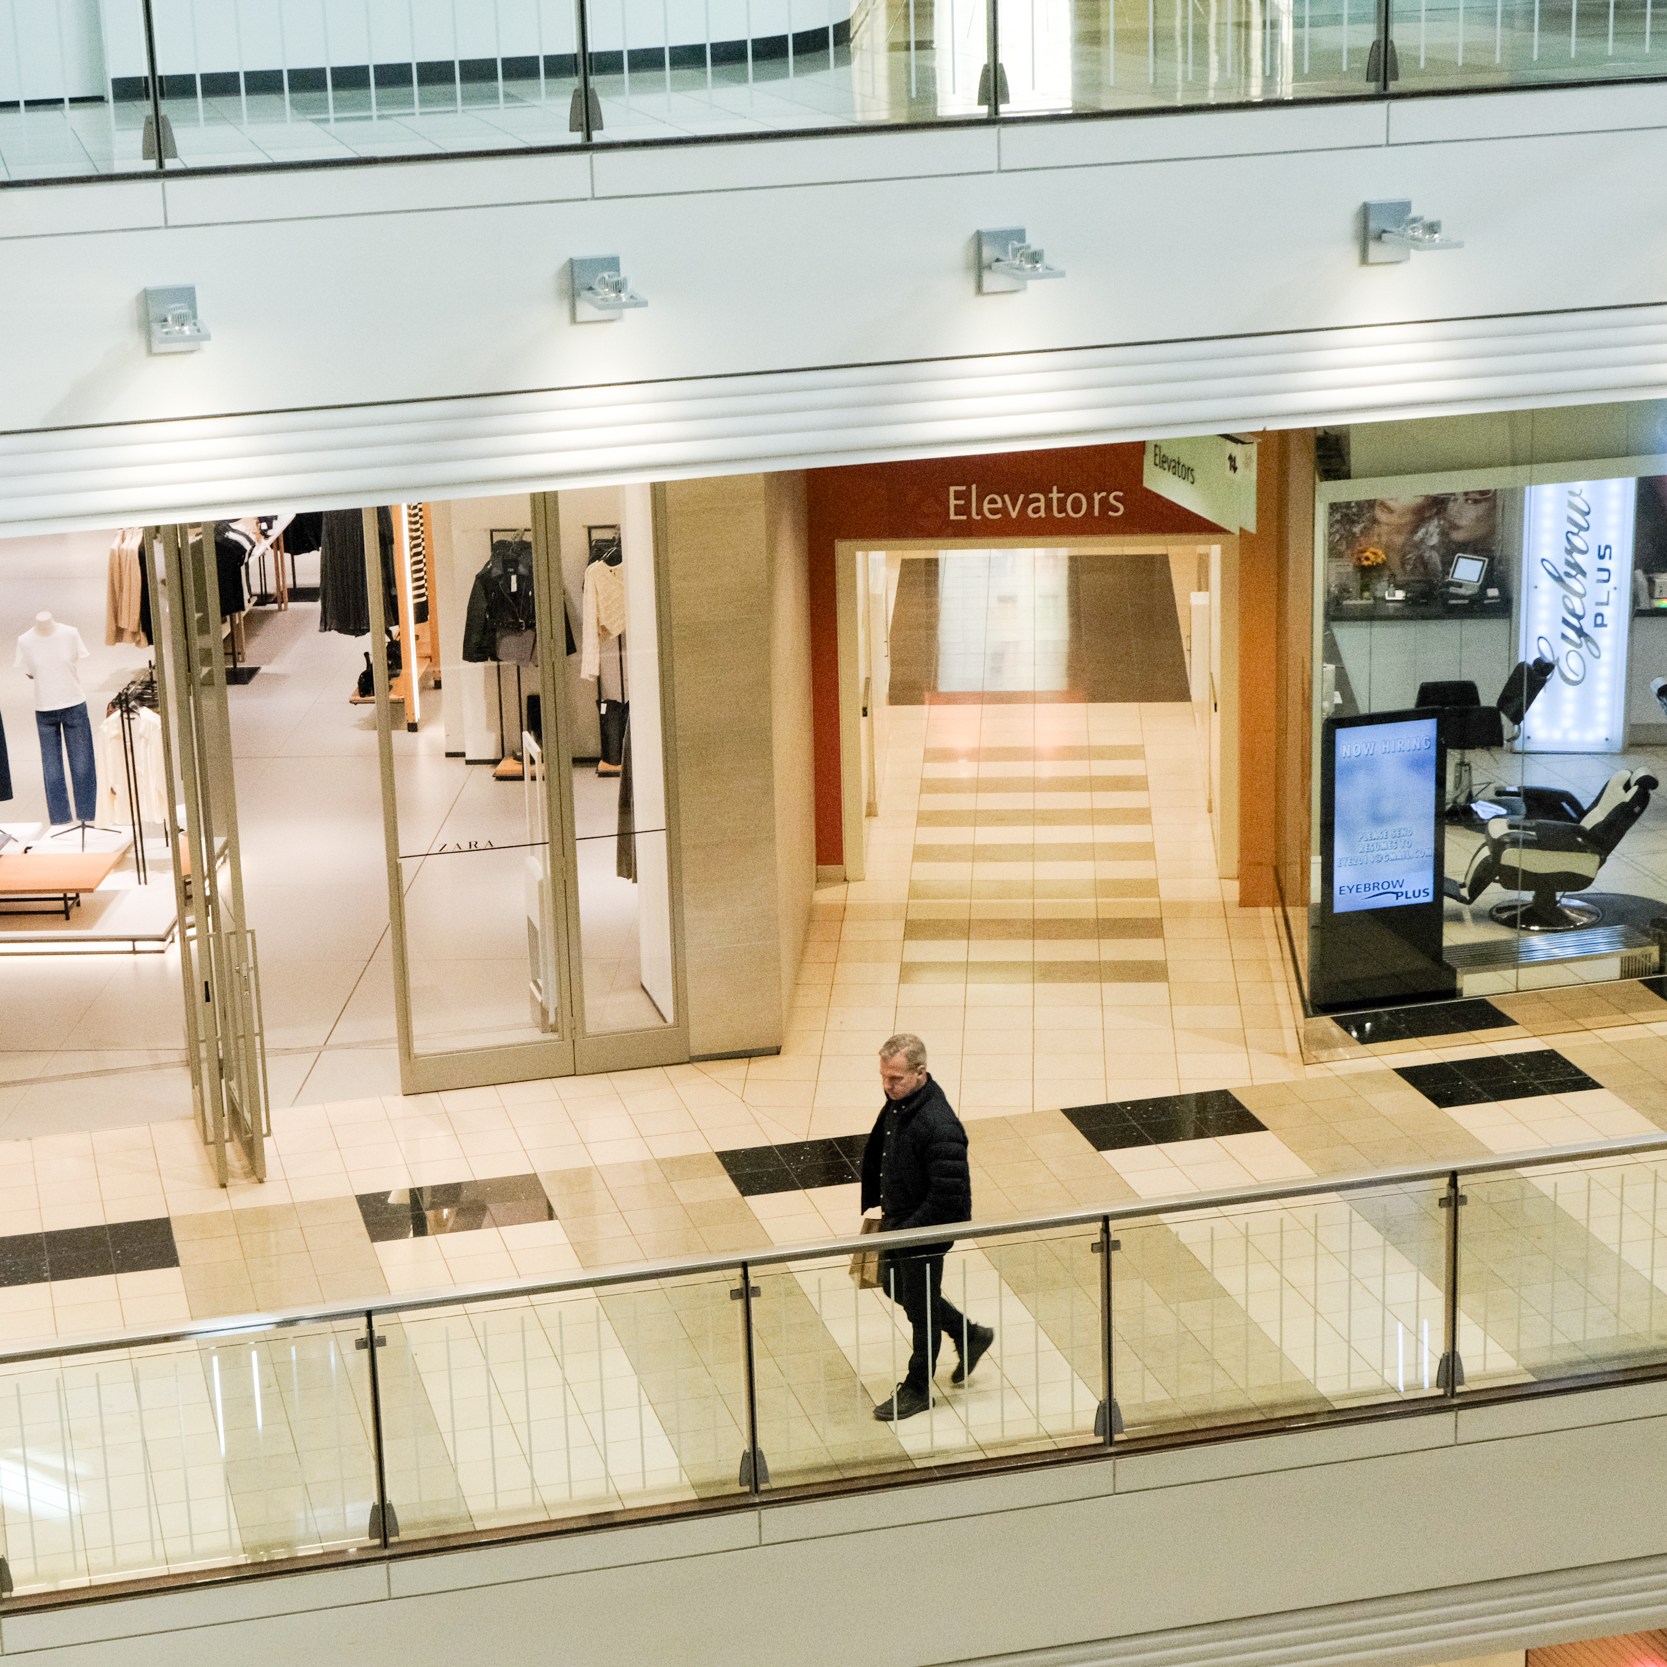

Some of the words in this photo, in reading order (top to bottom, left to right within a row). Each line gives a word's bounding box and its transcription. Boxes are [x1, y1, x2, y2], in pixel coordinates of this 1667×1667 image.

[1153, 444, 1195, 484] Elevators
[949, 483, 1125, 520] Elevators
[1537, 488, 1601, 686] Eyebrow
[1593, 544, 1612, 628] PLUS
[1342, 741, 1375, 758] NOW
[1382, 735, 1431, 754] HIRING
[1358, 830, 1388, 842] PLEASE
[1391, 827, 1413, 839] SEND
[438, 840, 494, 852] ZARA
[1358, 841, 1398, 854] RESUMES
[1400, 840, 1413, 849] TO
[1338, 879, 1405, 896] EYEBROW
[1395, 888, 1430, 901] PLUS
